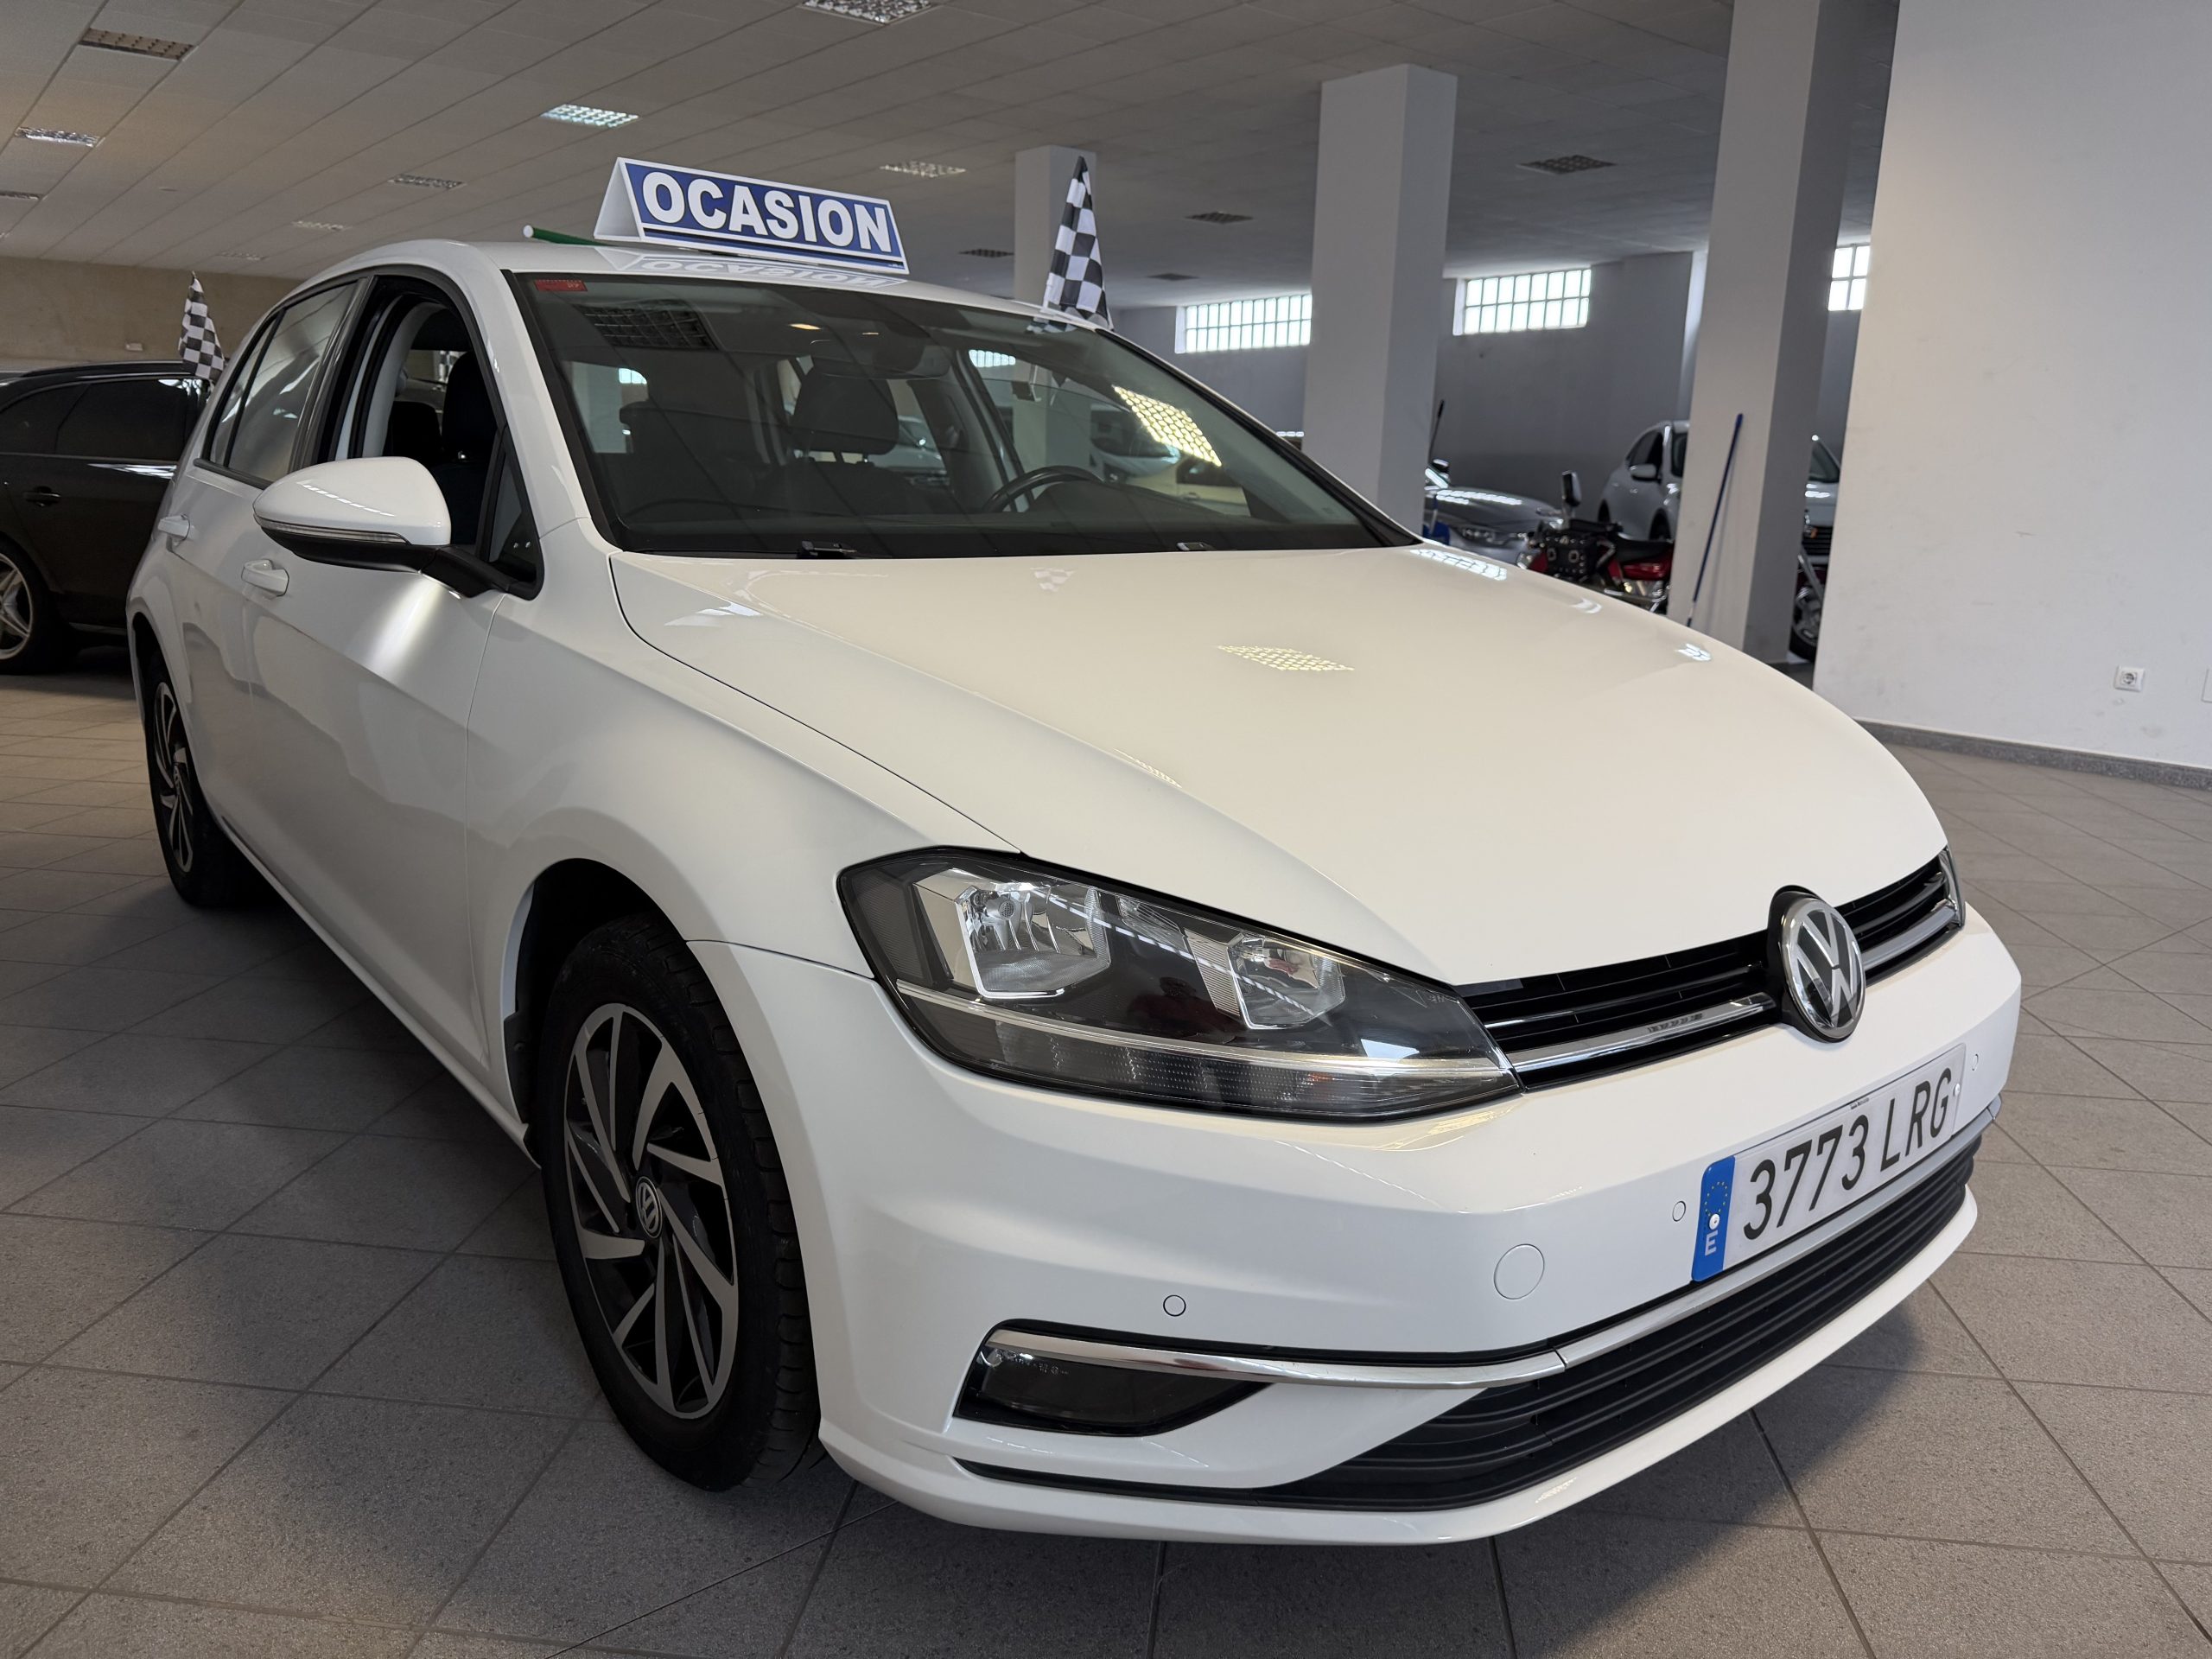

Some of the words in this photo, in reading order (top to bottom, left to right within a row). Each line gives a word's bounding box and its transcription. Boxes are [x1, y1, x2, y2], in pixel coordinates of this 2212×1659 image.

[642, 170, 893, 253] OCASION
[1789, 901, 1862, 1032] VW
[1743, 1114, 1869, 1241] 3773
[1880, 1067, 1953, 1172] LRG
[1704, 1230, 1719, 1256] E
